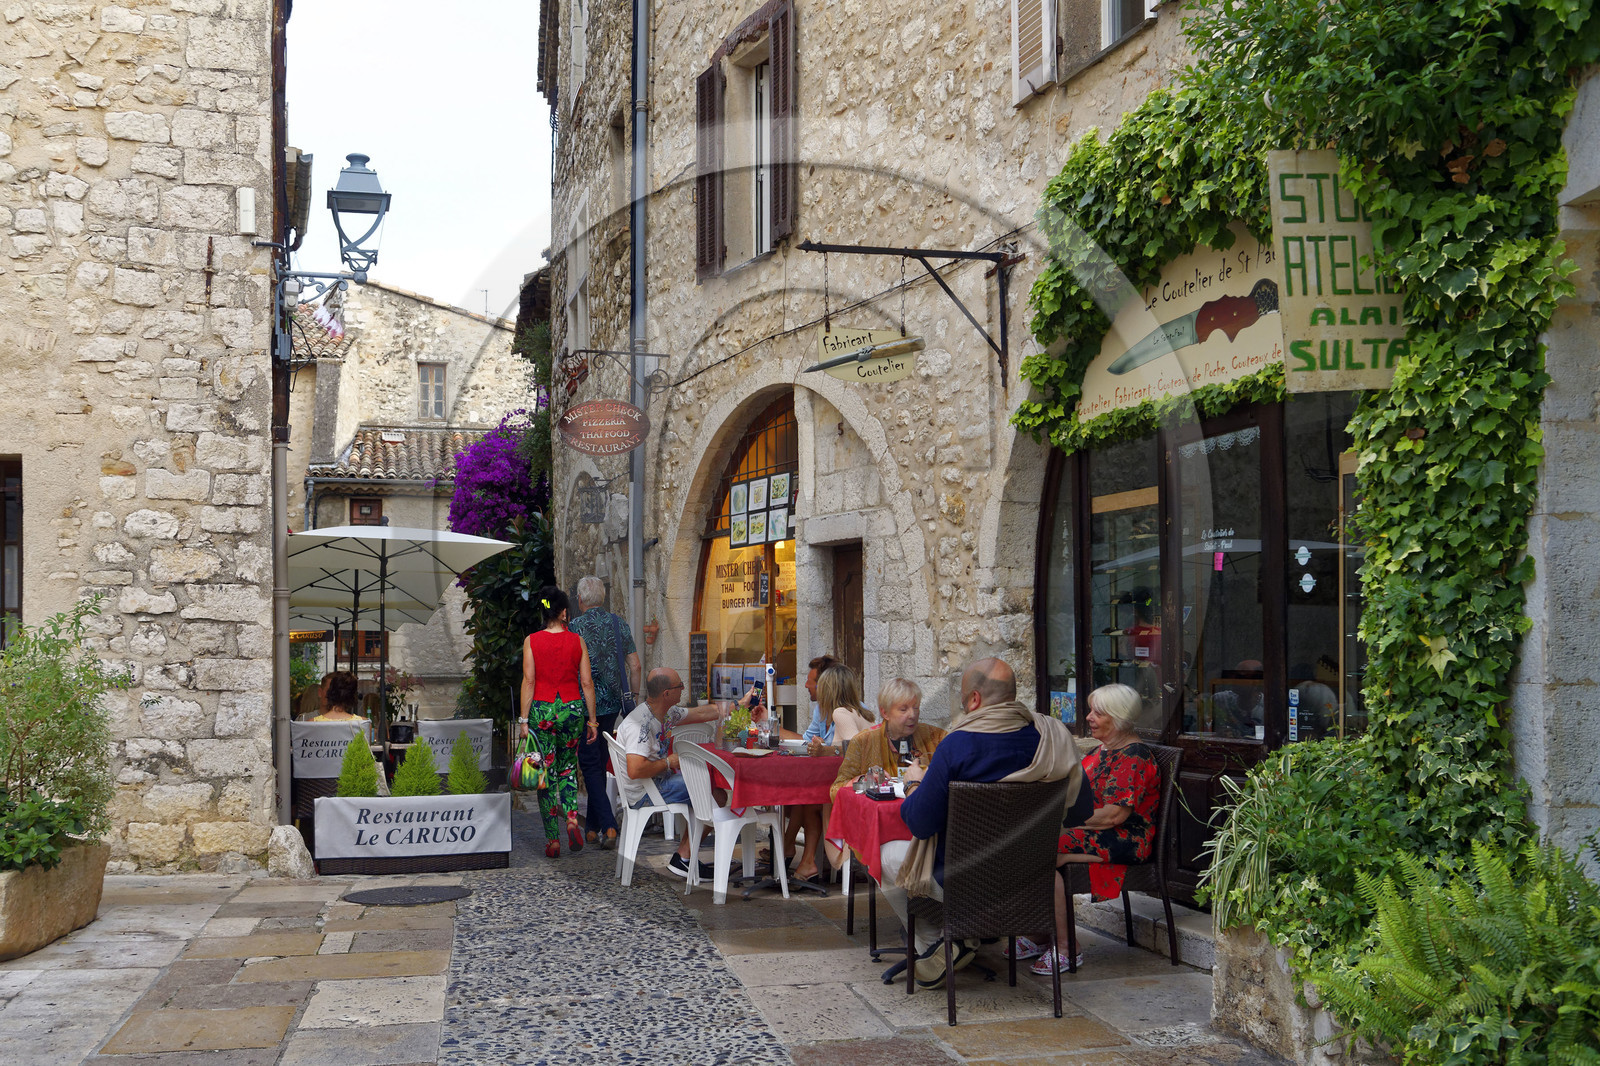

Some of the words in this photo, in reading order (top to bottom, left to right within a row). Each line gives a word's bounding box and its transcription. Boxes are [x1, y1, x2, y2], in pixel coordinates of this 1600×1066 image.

[1279, 173, 1371, 223] STU
[1145, 287, 1158, 311] Le
[1162, 267, 1213, 302] Coutelier
[1219, 258, 1232, 283] de
[1238, 250, 1251, 274] St
[1310, 306, 1398, 326] ALAI
[822, 332, 873, 354] Fabricant
[1289, 338, 1411, 372] SULTA
[857, 358, 905, 378] Coutelier
[1077, 394, 1111, 416] Coutelier
[1158, 376, 1190, 391] Couteaux
[1193, 367, 1201, 383] de
[1231, 352, 1269, 370] Couteaux
[1272, 343, 1282, 359] de
[564, 403, 603, 424] MISTER
[604, 403, 642, 422] CHECK
[582, 418, 626, 427] PIZZERIA
[580, 430, 603, 439] THAI
[604, 429, 630, 438] FOOD
[837, 422, 844, 436] 5
[570, 433, 641, 453] RESTAURANT
[716, 562, 739, 578] MISTER
[721, 583, 735, 593] THAI
[722, 598, 746, 609] BURGER
[301, 738, 353, 747] Restaura
[428, 736, 483, 745] Restant
[301, 749, 312, 758] Le
[315, 748, 345, 758] CARU
[355, 806, 475, 825] Restaurant
[354, 829, 379, 846] Le
[385, 825, 476, 844] CARUSO
